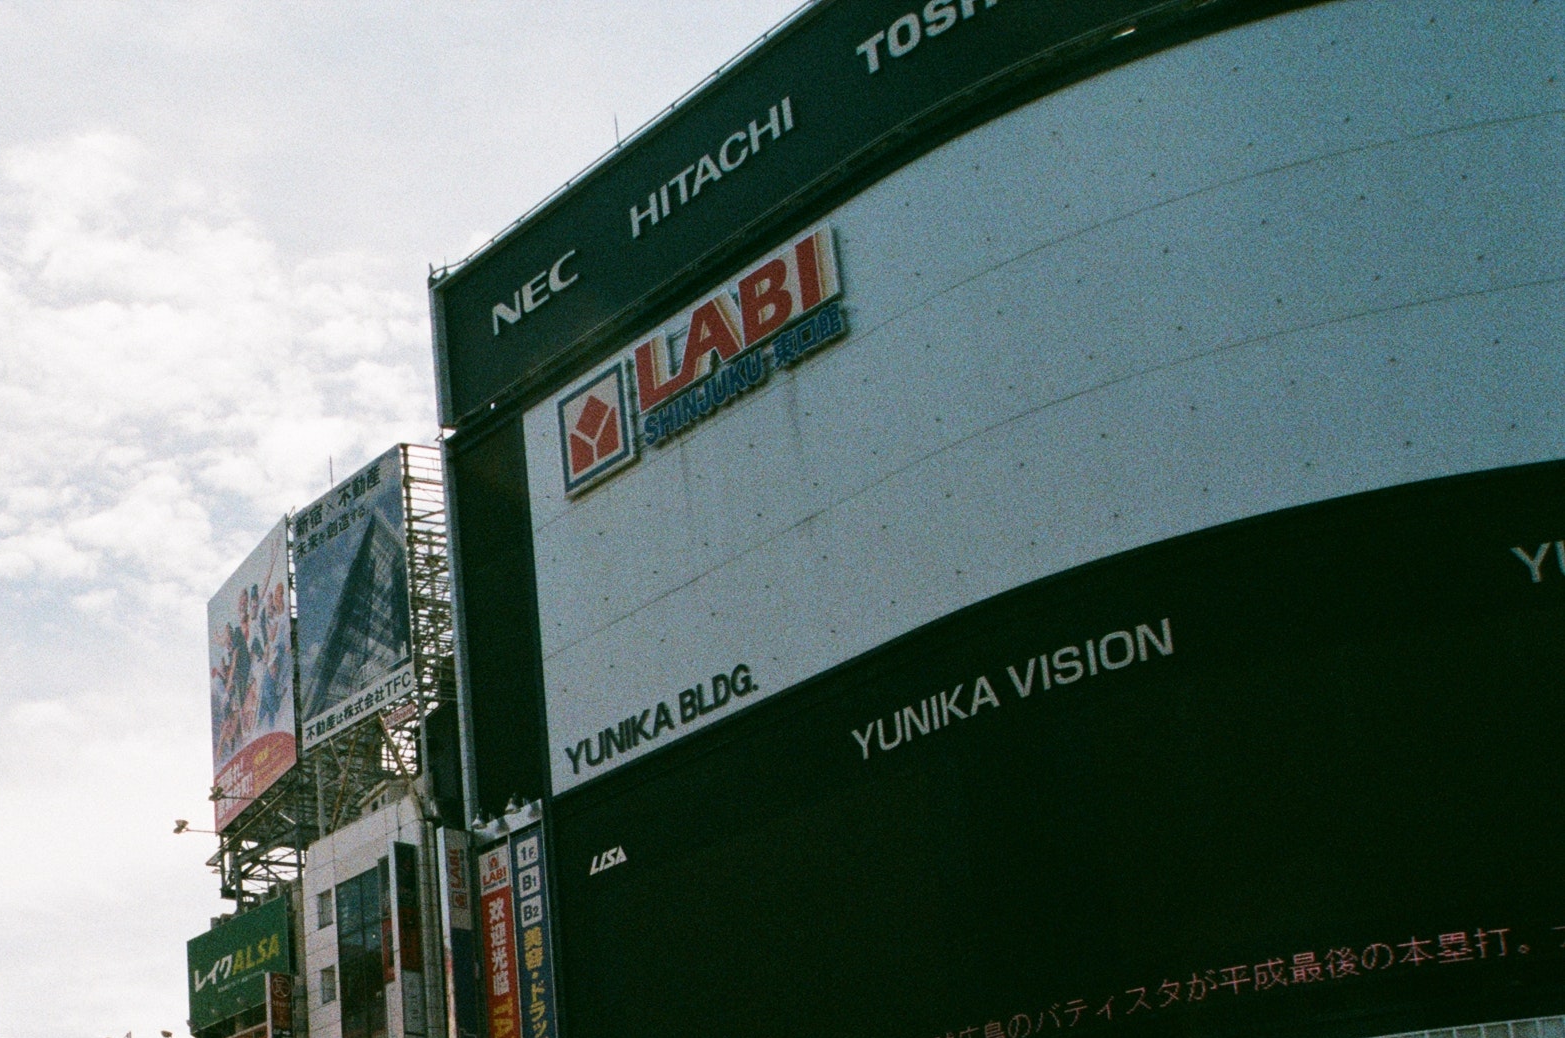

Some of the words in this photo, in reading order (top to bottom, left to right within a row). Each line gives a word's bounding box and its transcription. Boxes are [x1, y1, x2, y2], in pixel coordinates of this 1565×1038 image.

[629, 96, 795, 238] HITACHI
[491, 250, 579, 335] NEC
[635, 230, 828, 412] LABI
[644, 352, 763, 446] SHINJUKU
[773, 307, 842, 367] 東口館
[565, 703, 674, 775] YUNIKA
[678, 664, 758, 726] BLDG.
[851, 675, 1000, 760] YUNIKA
[1007, 617, 1176, 700] VISION
